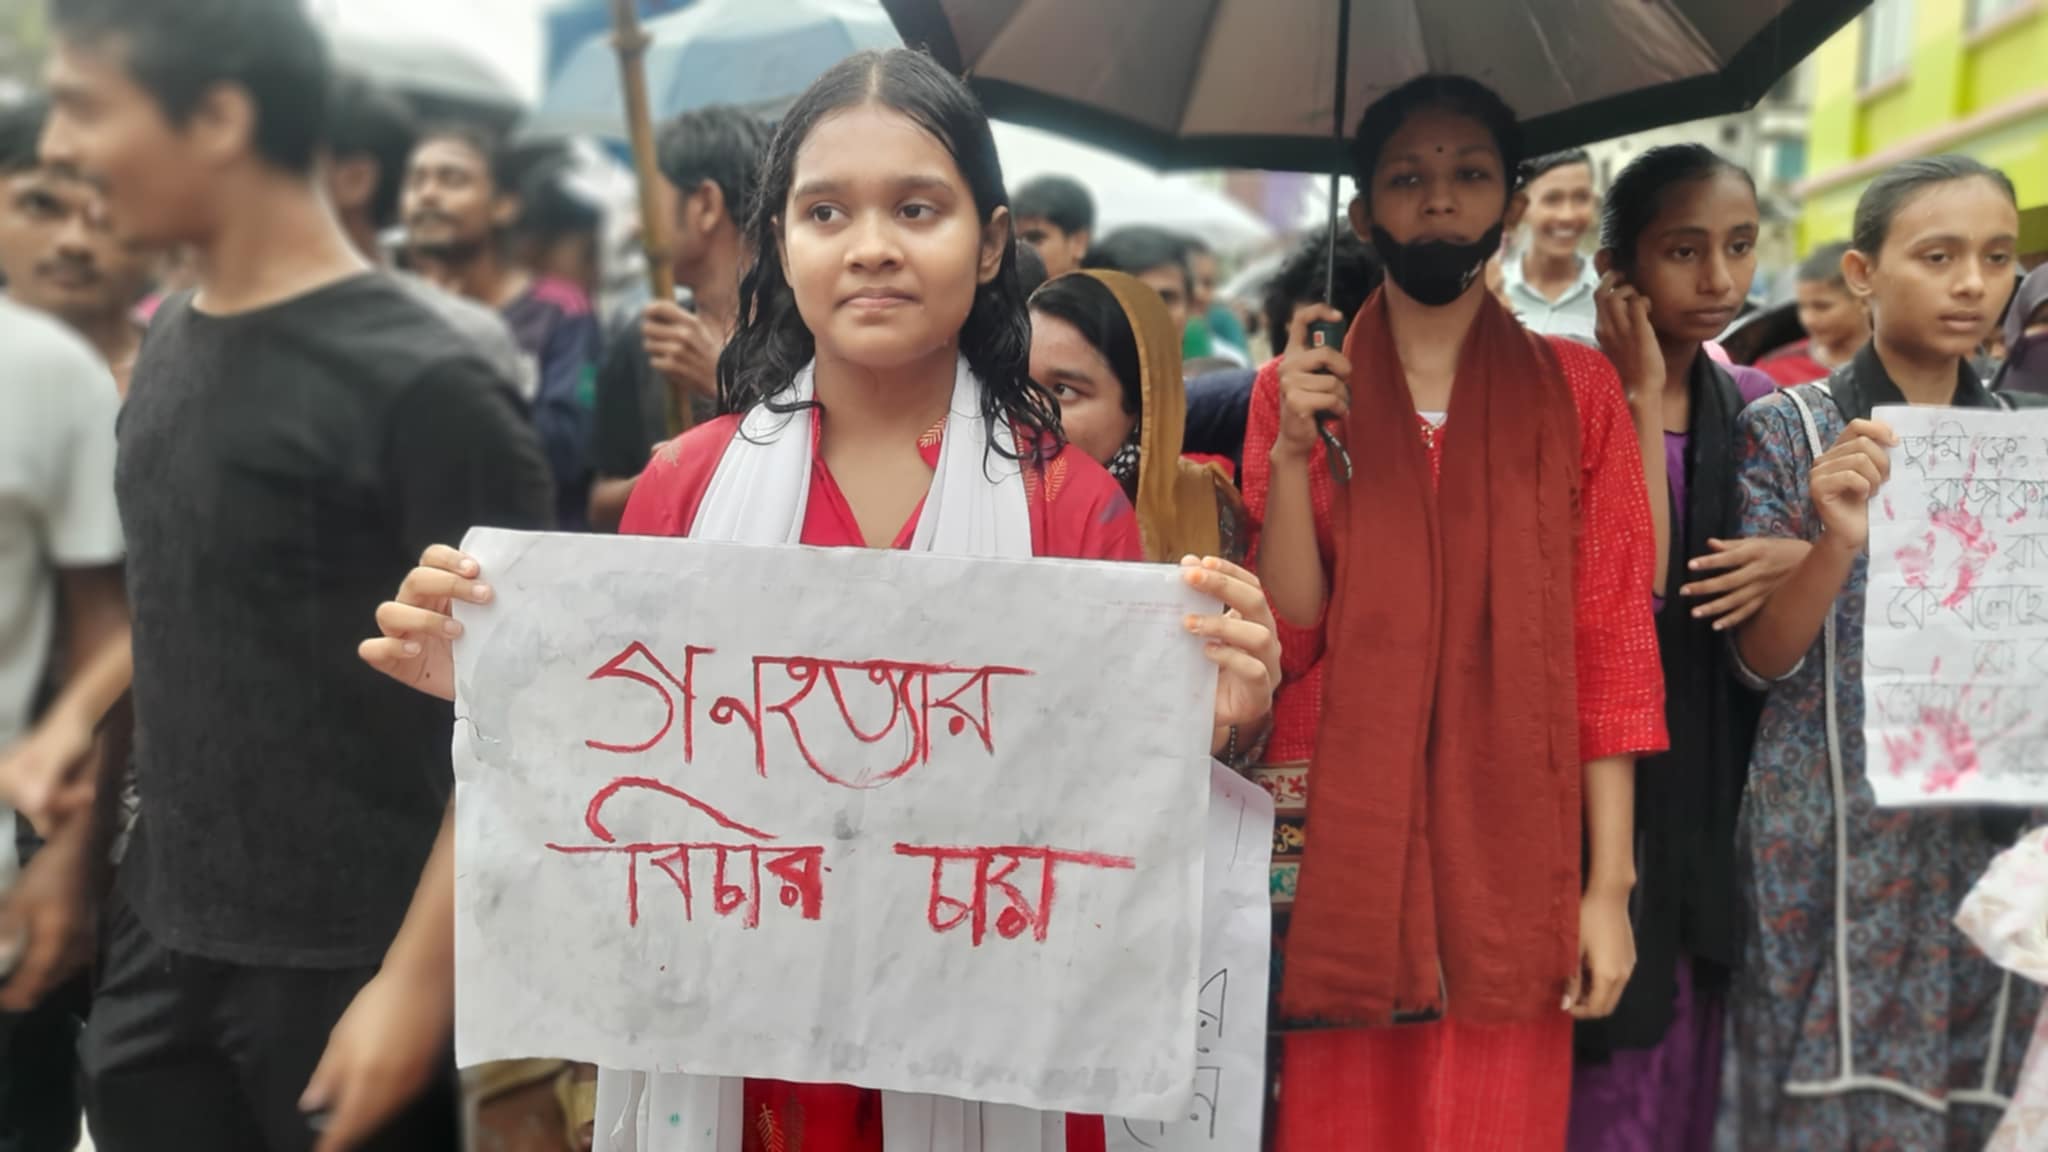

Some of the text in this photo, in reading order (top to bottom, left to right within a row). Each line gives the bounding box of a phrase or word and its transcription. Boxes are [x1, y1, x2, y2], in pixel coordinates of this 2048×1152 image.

[588, 641, 1033, 788] গনহত্যার
[548, 776, 1135, 947] বিচার চায়
